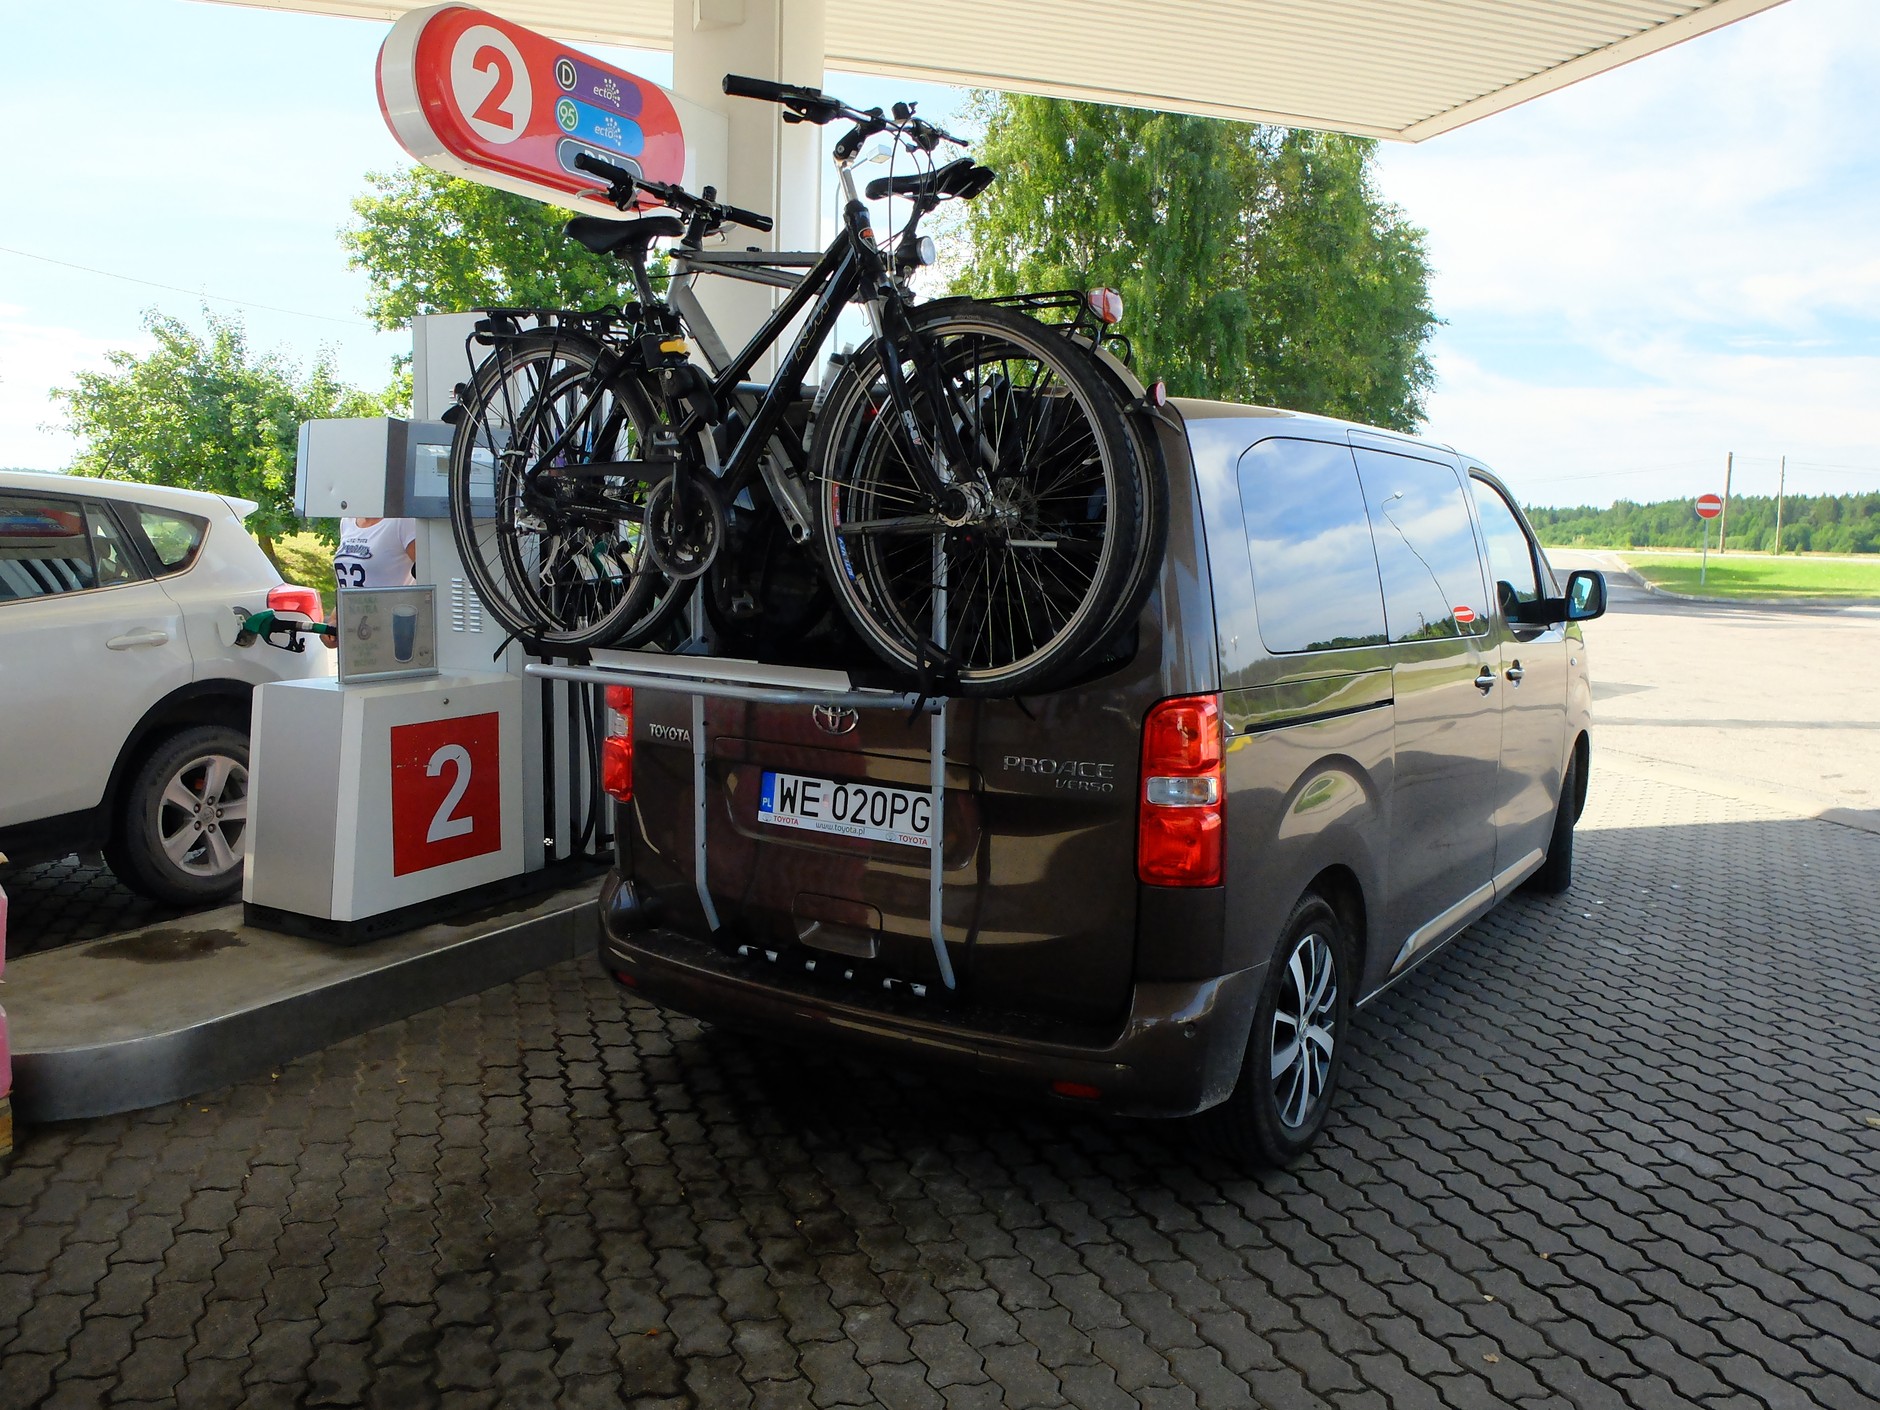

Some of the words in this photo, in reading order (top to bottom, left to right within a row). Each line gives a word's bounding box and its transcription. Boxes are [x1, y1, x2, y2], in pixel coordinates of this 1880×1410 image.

[562, 64, 573, 85] D
[472, 45, 514, 130] 2
[593, 86, 612, 100] ecto
[560, 105, 575, 126] 95
[594, 125, 614, 139] ecto
[357, 615, 372, 641] 6
[649, 723, 692, 744] TOYOTA
[1003, 755, 1115, 779] PROACE
[426, 744, 473, 844] 2
[1055, 778, 1114, 792] VERSO
[762, 797, 772, 808] PL
[779, 777, 821, 818] WE
[831, 785, 931, 833] 020PG
[773, 815, 799, 826] TOYOTA
[815, 821, 866, 837] www.toyota.pl
[898, 834, 928, 846] TOYOTA
